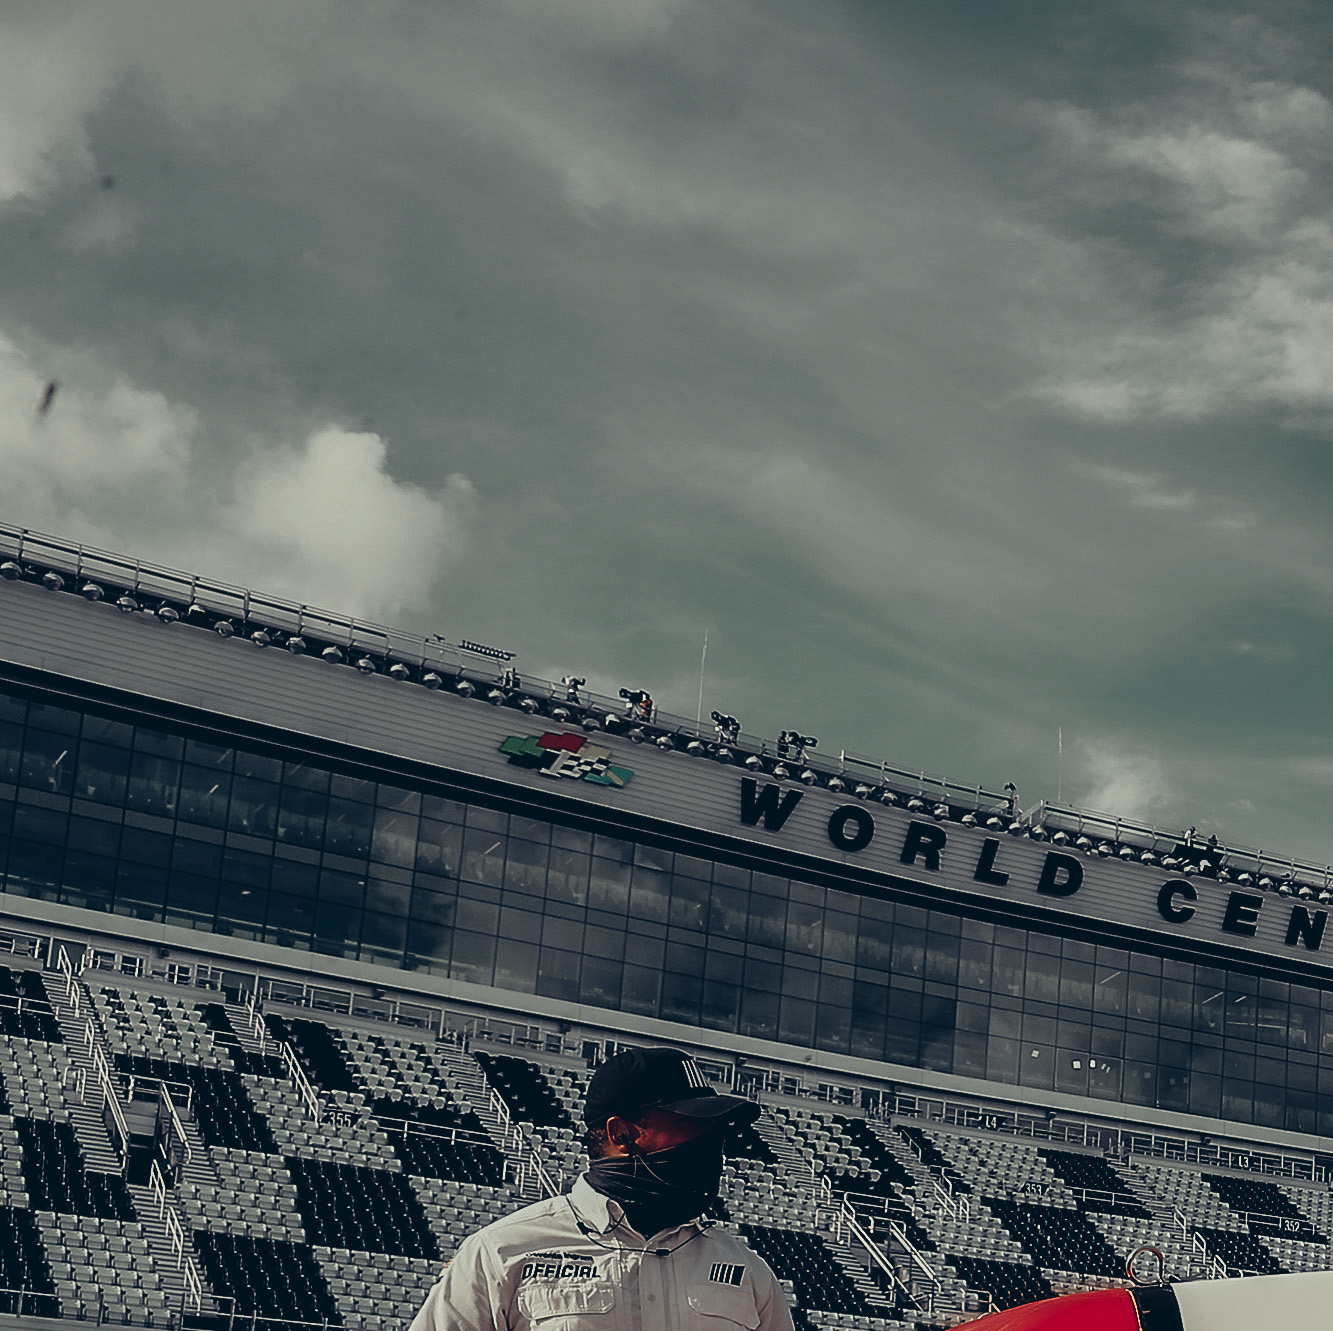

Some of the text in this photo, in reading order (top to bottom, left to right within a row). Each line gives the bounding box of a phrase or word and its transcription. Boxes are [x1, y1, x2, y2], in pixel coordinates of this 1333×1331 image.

[741, 776, 1084, 896] WORLD
[328, 1111, 352, 1128] 355
[985, 1115, 997, 1129] L4
[1237, 1155, 1249, 1168] L3
[1026, 1183, 1042, 1196] 353
[1284, 1219, 1300, 1232] 352
[521, 1262, 601, 1281] OFFICIAL
